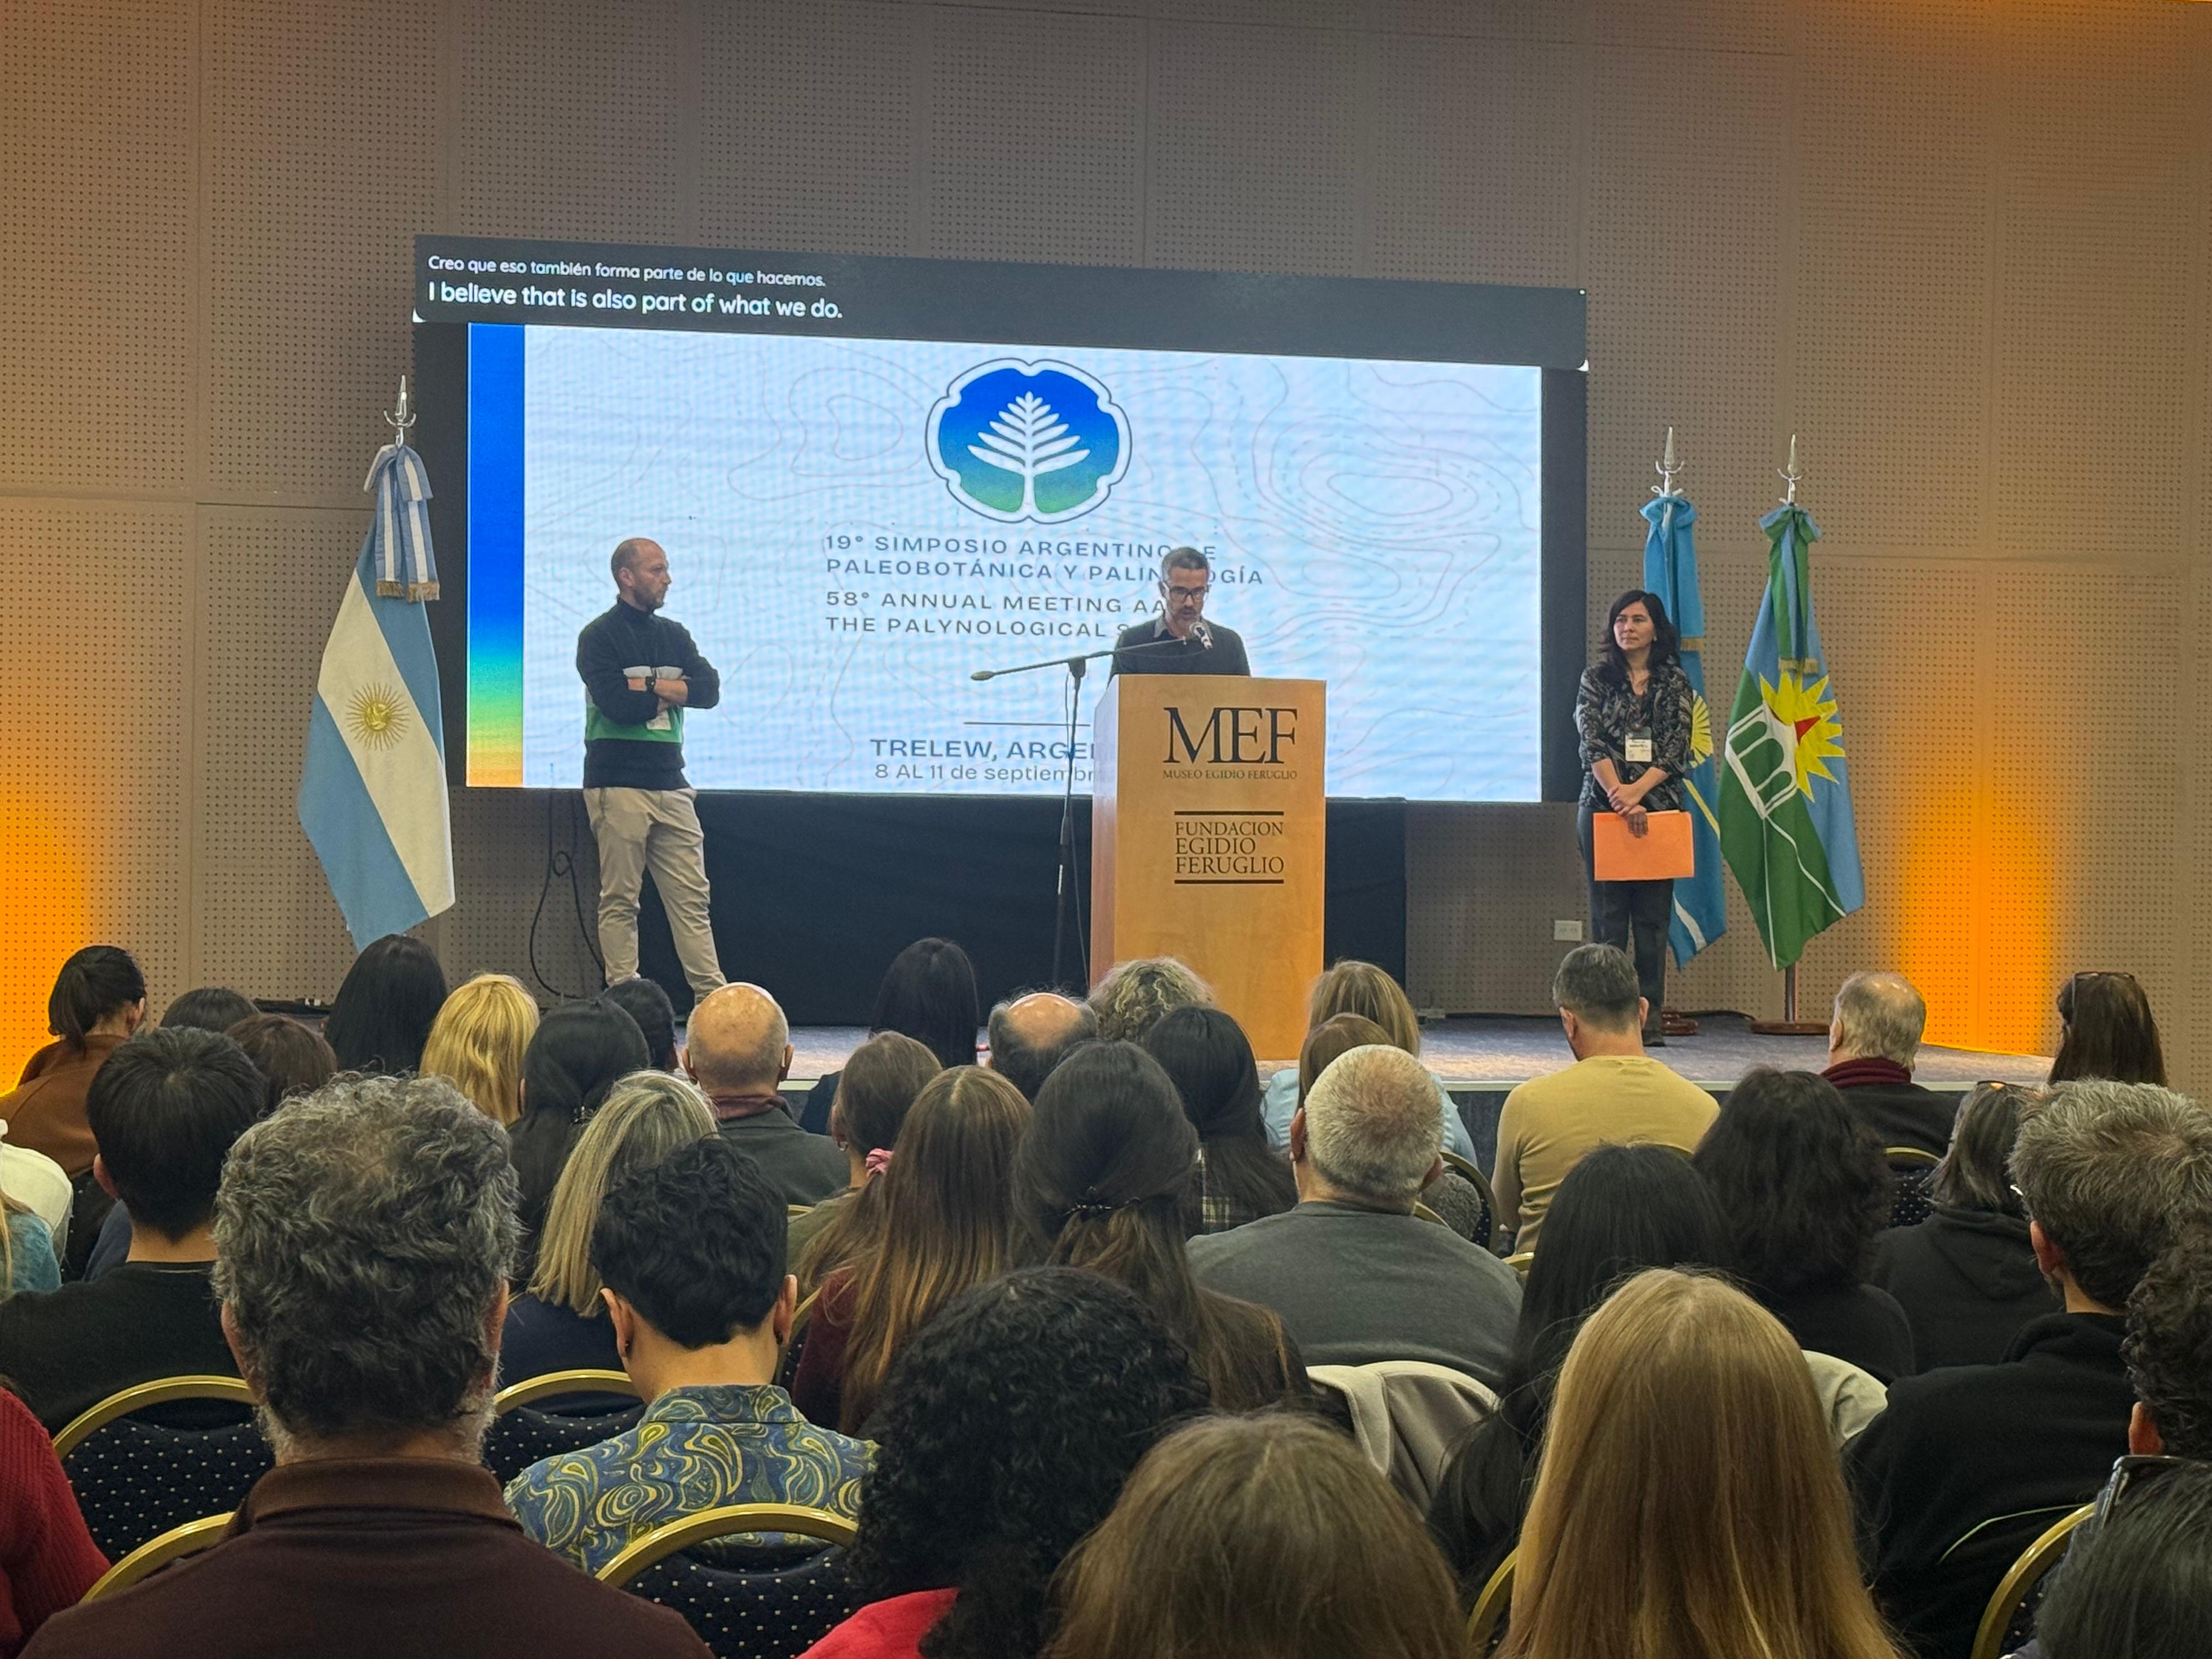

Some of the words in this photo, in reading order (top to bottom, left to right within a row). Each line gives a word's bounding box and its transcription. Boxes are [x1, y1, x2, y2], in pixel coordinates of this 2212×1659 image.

[428, 255, 465, 271] Creo
[468, 260, 496, 274] que
[500, 261, 527, 273] eso
[531, 261, 591, 276] también
[595, 262, 640, 279] forma
[644, 267, 684, 281] parte
[687, 267, 706, 281] de
[709, 268, 723, 283] lo
[726, 272, 754, 286] que
[757, 270, 826, 287] hacemos.
[429, 281, 435, 301] I
[441, 281, 517, 304] believe
[522, 285, 566, 307] that
[571, 289, 588, 308] is
[592, 288, 637, 309] also
[642, 294, 687, 314] part
[692, 292, 715, 313] of
[719, 294, 771, 315] what
[775, 301, 806, 317] we
[811, 298, 843, 319] do.
[826, 535, 864, 549] 19°
[875, 537, 1007, 554] SIMPOSIO
[1203, 546, 1216, 560] E
[827, 558, 1052, 579] PALEOBOTÁNICA
[1064, 565, 1077, 579] Y
[827, 591, 870, 606] 58°
[881, 593, 992, 610] ANNUAL
[1004, 596, 1121, 613] MEETING
[1133, 600, 1165, 613] AA
[826, 617, 876, 631] THE
[888, 618, 1106, 637] PALYNOLOGICAL
[1163, 707, 1297, 764] MEF
[870, 739, 997, 761] TRELEW,
[874, 764, 889, 778] 8
[896, 764, 923, 779] AL
[930, 764, 943, 779] 11
[951, 765, 977, 780] de
[984, 765, 1093, 783] septiembr
[1163, 770, 1203, 780] MUSEO
[1206, 770, 1245, 780] EGIDIO
[1248, 770, 1297, 780] FERUGLIO
[1175, 821, 1284, 836] FUNDACION
[1175, 837, 1256, 855] EGIDIO
[1175, 856, 1284, 874] FERUGLIO
